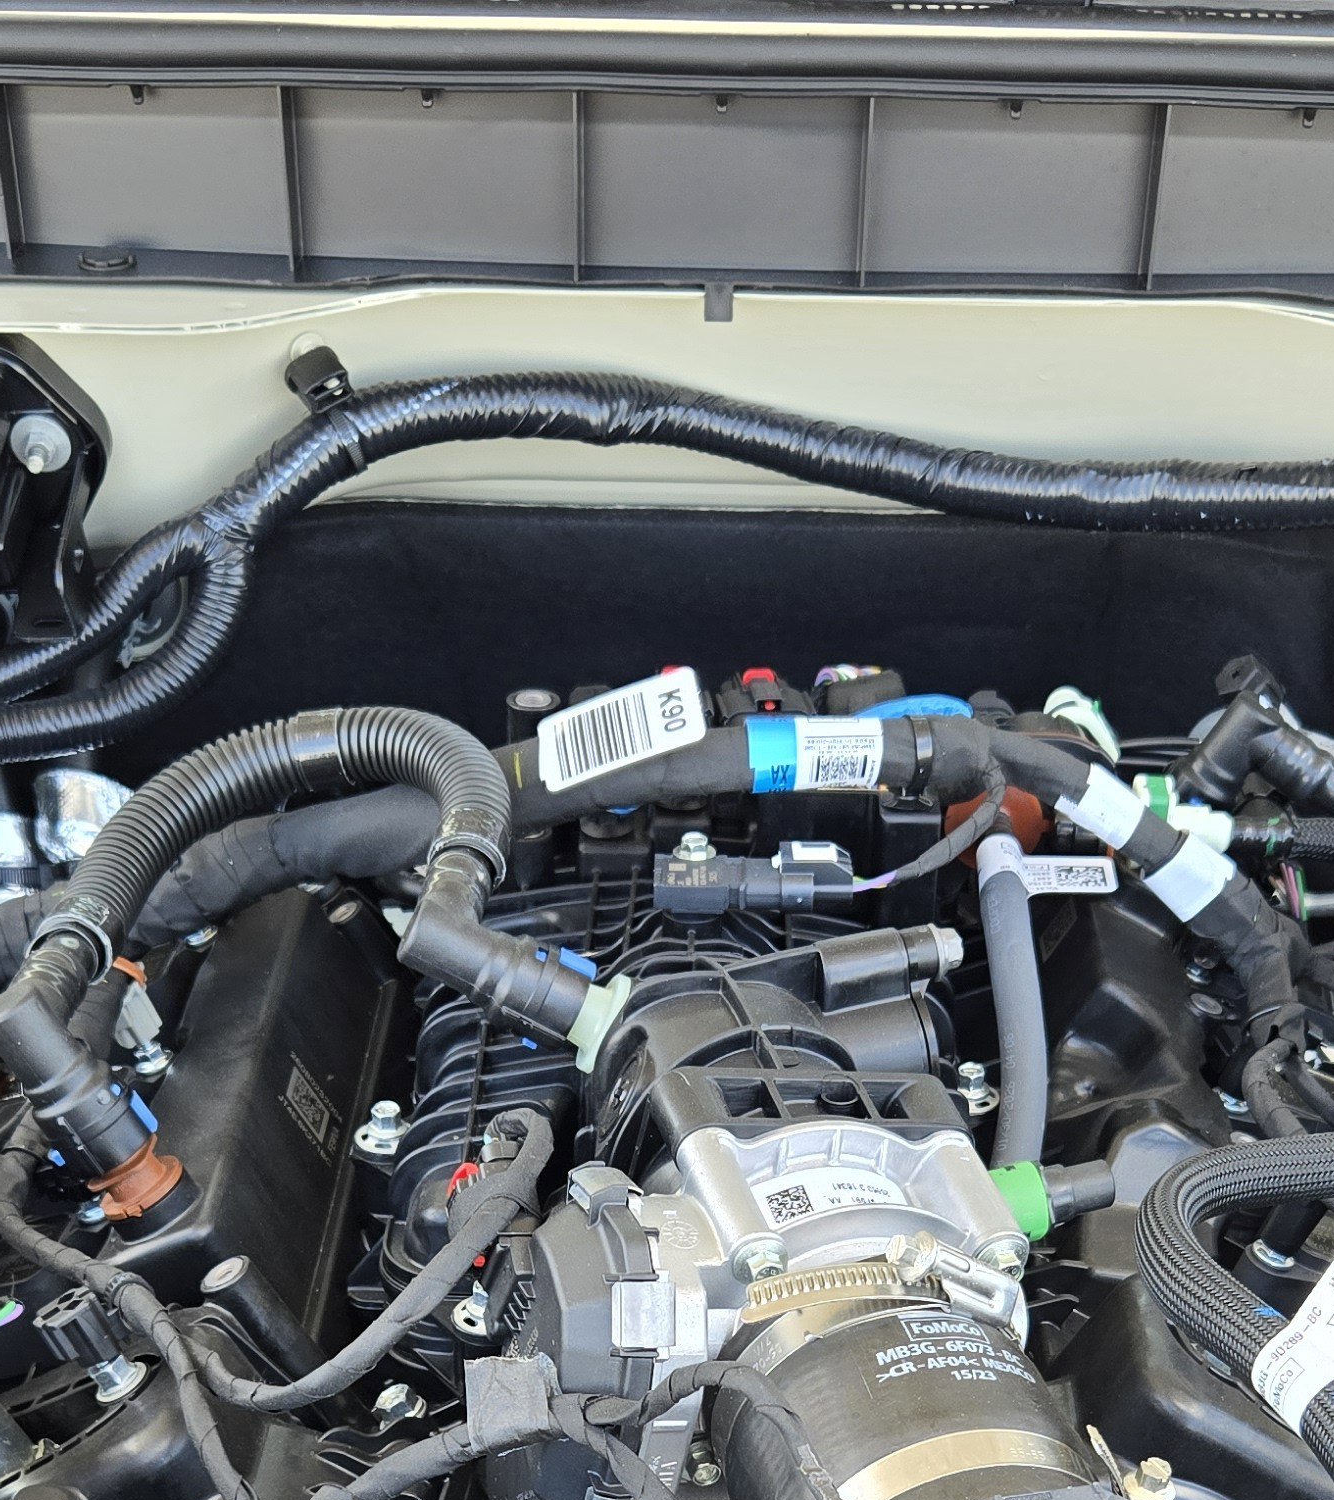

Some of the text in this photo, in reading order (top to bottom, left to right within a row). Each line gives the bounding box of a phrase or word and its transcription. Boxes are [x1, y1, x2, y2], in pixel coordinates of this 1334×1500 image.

[658, 688, 687, 732] K90
[910, 1321, 982, 1337] FoMoCo
[950, 1369, 997, 1382] 15/23
[981, 1356, 1037, 1384] MEXICO
